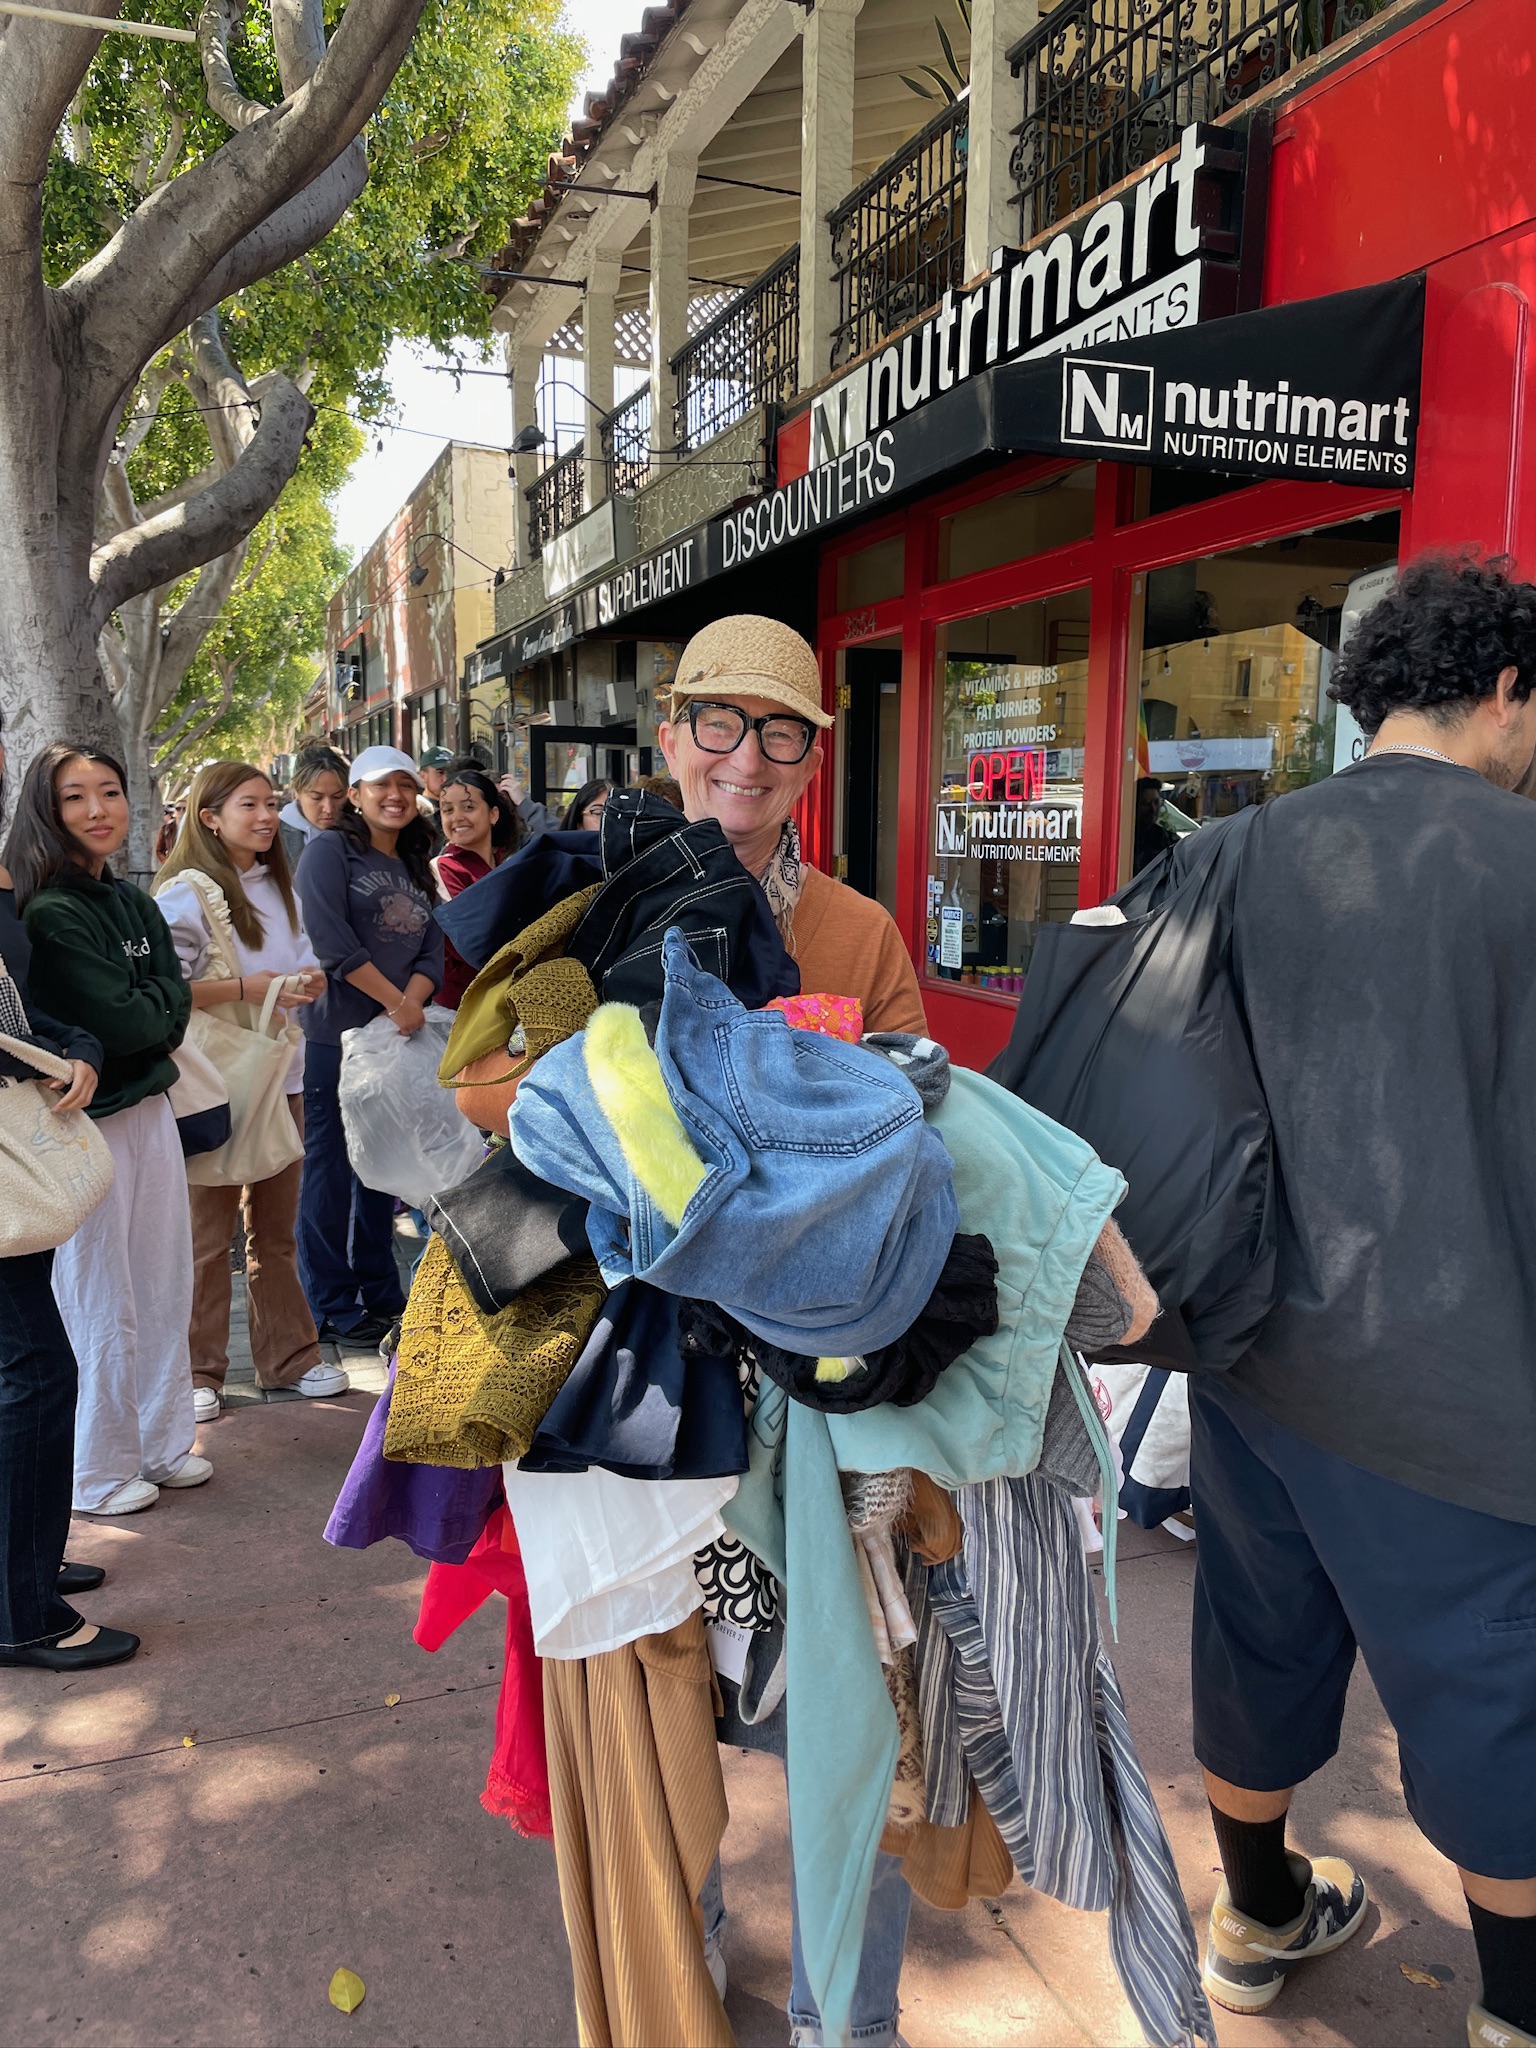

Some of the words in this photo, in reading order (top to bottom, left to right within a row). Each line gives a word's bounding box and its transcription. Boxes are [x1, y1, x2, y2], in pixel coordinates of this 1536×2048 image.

[869, 121, 1206, 431] nutrimart
[1164, 378, 1410, 446] nutrimart
[1163, 431, 1289, 465] NUTRITION
[1294, 444, 1408, 476] ELEMENTS
[598, 538, 694, 624] SUPPLEMENT
[722, 429, 895, 569] DISCOUNTERS
[964, 673, 1011, 697] VITAMINS
[1013, 672, 1022, 689] &
[1024, 665, 1059, 688] HERBS
[976, 704, 994, 722] FAT
[995, 697, 1042, 720] BURNERS
[963, 729, 1003, 750] PROTEIN
[1005, 723, 1057, 745] POWDERS
[969, 750, 1045, 801] OPEN
[970, 801, 1083, 840] nutrimart
[970, 843, 1023, 861] NUTRITION
[349, 870, 395, 897] LUCKY
[943, 910, 961, 920] NOTICE
[713, 1623, 737, 1639] FOREVER
[737, 1633, 745, 1643] 21
[1220, 1915, 1248, 1938] NIKE
[1478, 2022, 1512, 2048] NIKE
